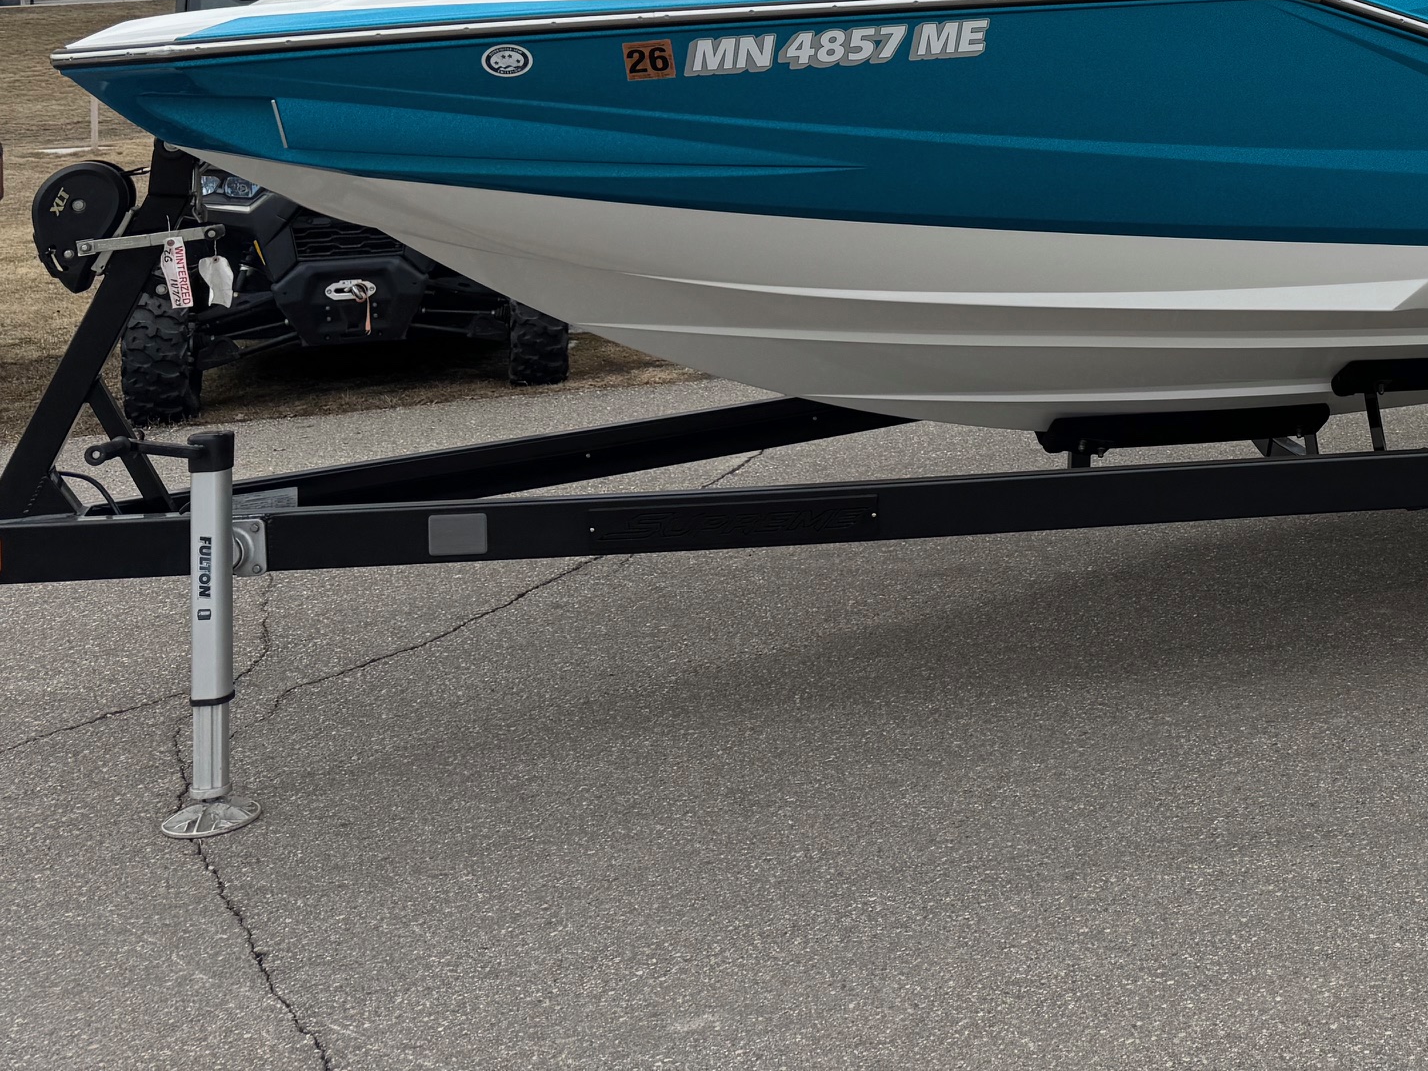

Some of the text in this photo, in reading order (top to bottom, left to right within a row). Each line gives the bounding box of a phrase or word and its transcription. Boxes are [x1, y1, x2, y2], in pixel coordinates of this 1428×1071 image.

[626, 46, 670, 74] 26
[688, 34, 775, 74] MN
[781, 24, 907, 67] 4857
[913, 19, 989, 58] ME
[50, 187, 70, 217] XLT
[174, 245, 191, 305] WINTERIZED
[198, 535, 212, 598] FULTON
